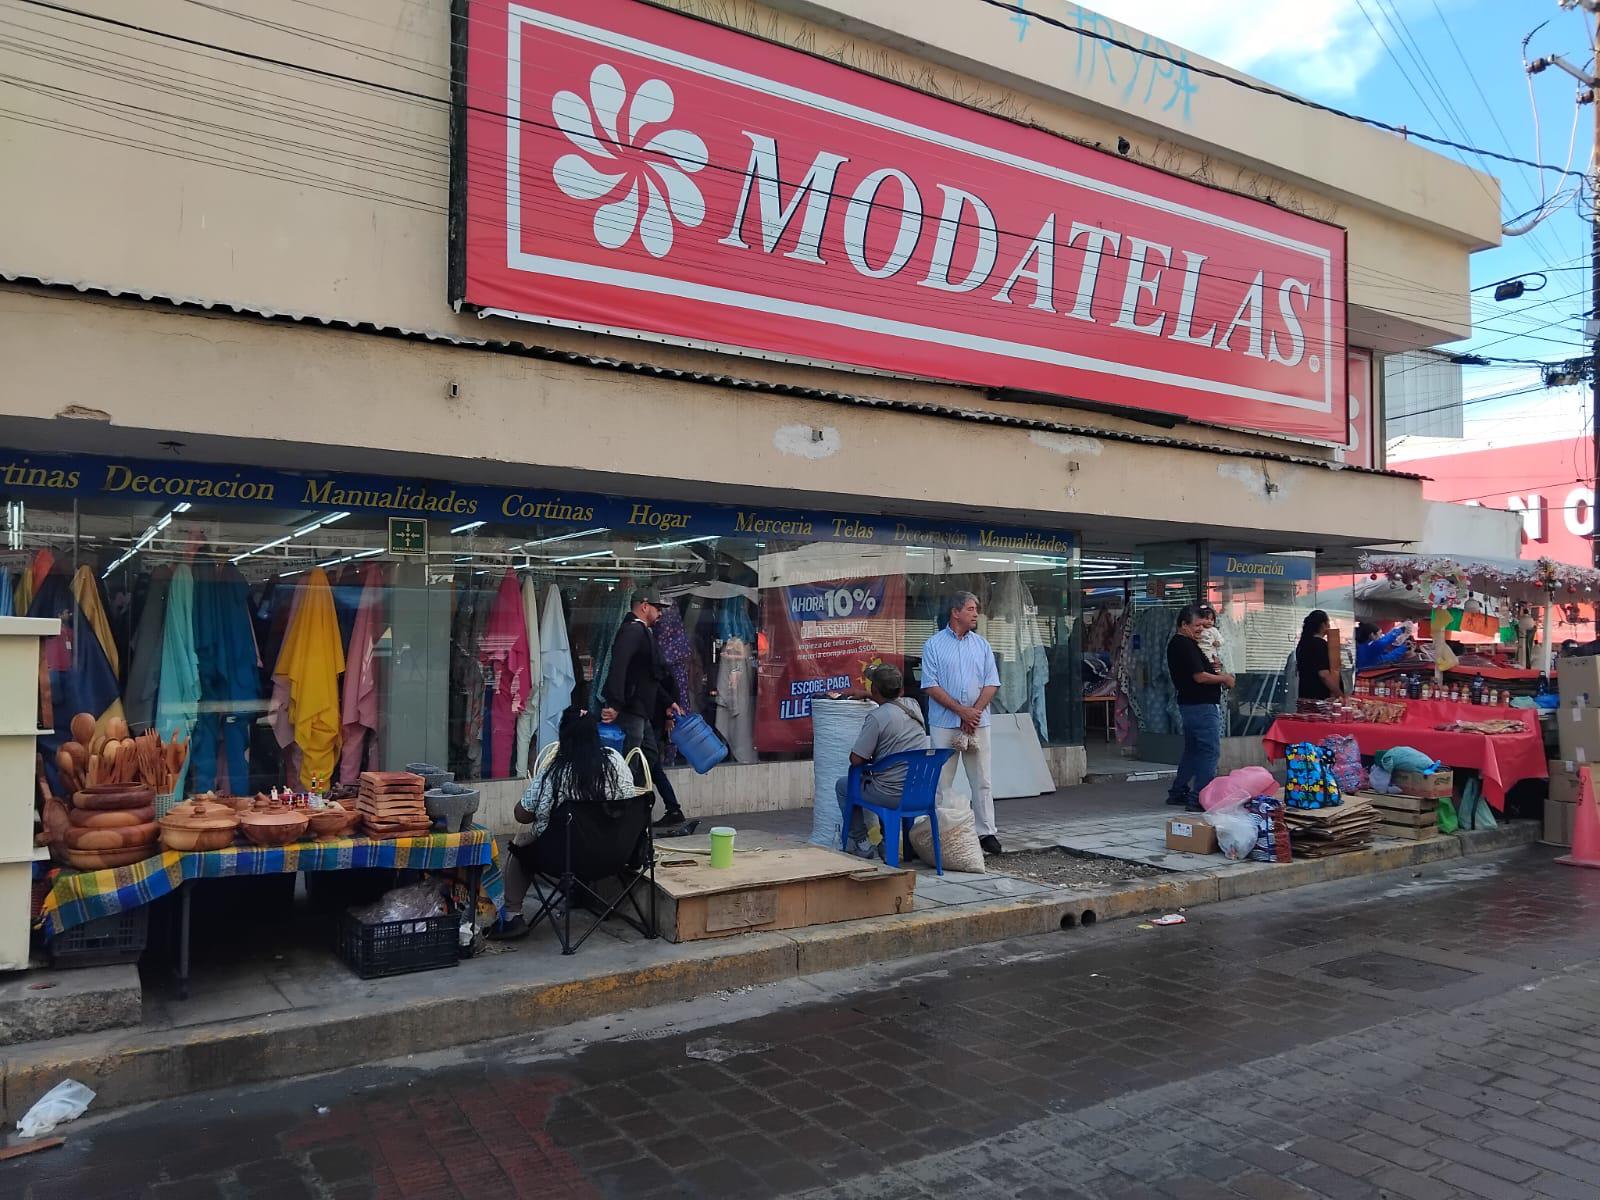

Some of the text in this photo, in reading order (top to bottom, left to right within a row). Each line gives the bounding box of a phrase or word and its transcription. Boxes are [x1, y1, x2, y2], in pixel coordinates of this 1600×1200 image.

[718, 130, 1311, 367] MODATELAS
[101, 465, 275, 500] Decoracion
[302, 480, 478, 514] Manualidades
[502, 495, 594, 521] Cortinas
[627, 504, 692, 531] Hogar
[734, 512, 813, 535] Merceria
[832, 518, 874, 539] Telas
[978, 529, 1068, 553] Manualidades
[1464, 487, 1595, 544] NO
[1226, 557, 1284, 576] Decoración
[791, 588, 877, 617] AHORA 10%
[801, 621, 869, 638] DE DESCUENTO
[791, 675, 851, 696] ESCOGE, PAGA
